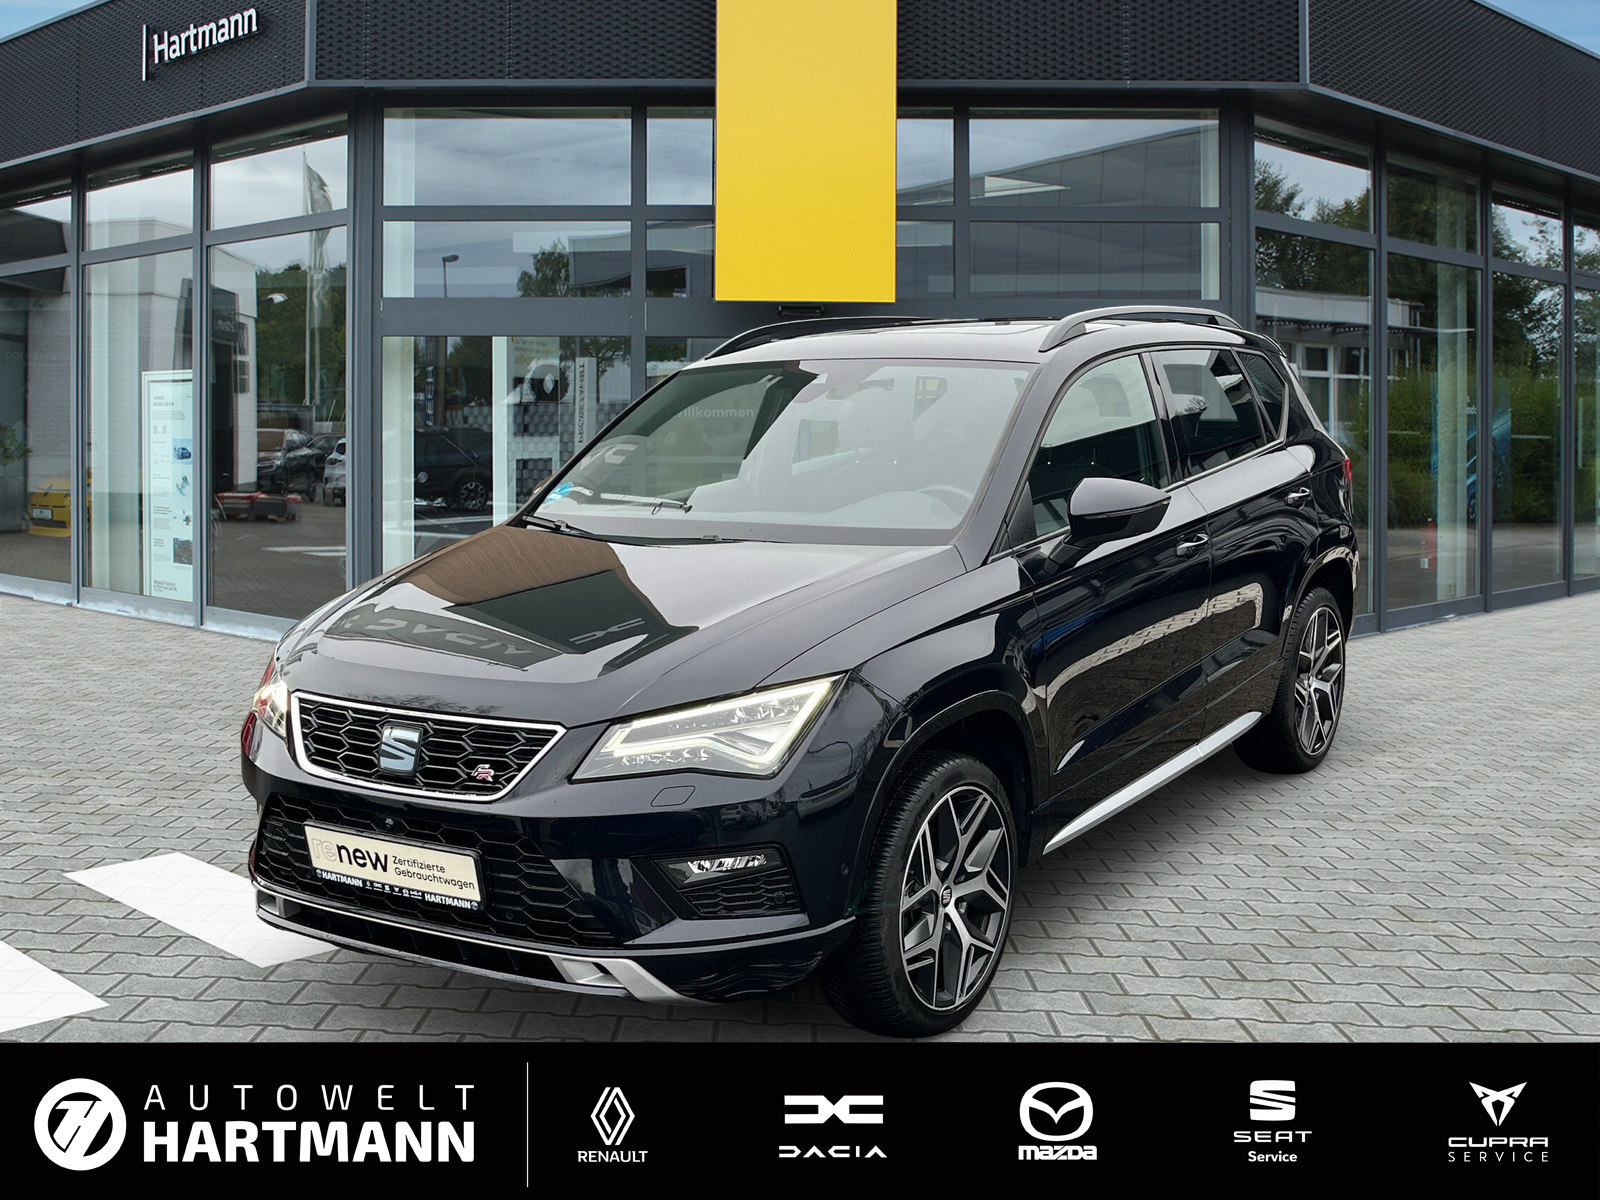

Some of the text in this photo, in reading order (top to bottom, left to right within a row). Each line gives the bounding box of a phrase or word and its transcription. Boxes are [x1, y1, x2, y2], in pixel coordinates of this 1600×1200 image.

[153, 8, 258, 64] Hartmann
[677, 406, 755, 418] illkommen
[311, 838, 388, 873] renew
[392, 855, 446, 874] Zertifizierte
[322, 871, 472, 909] HARTMANN HARTMANN
[394, 866, 475, 890] Gebrauchtwagen
